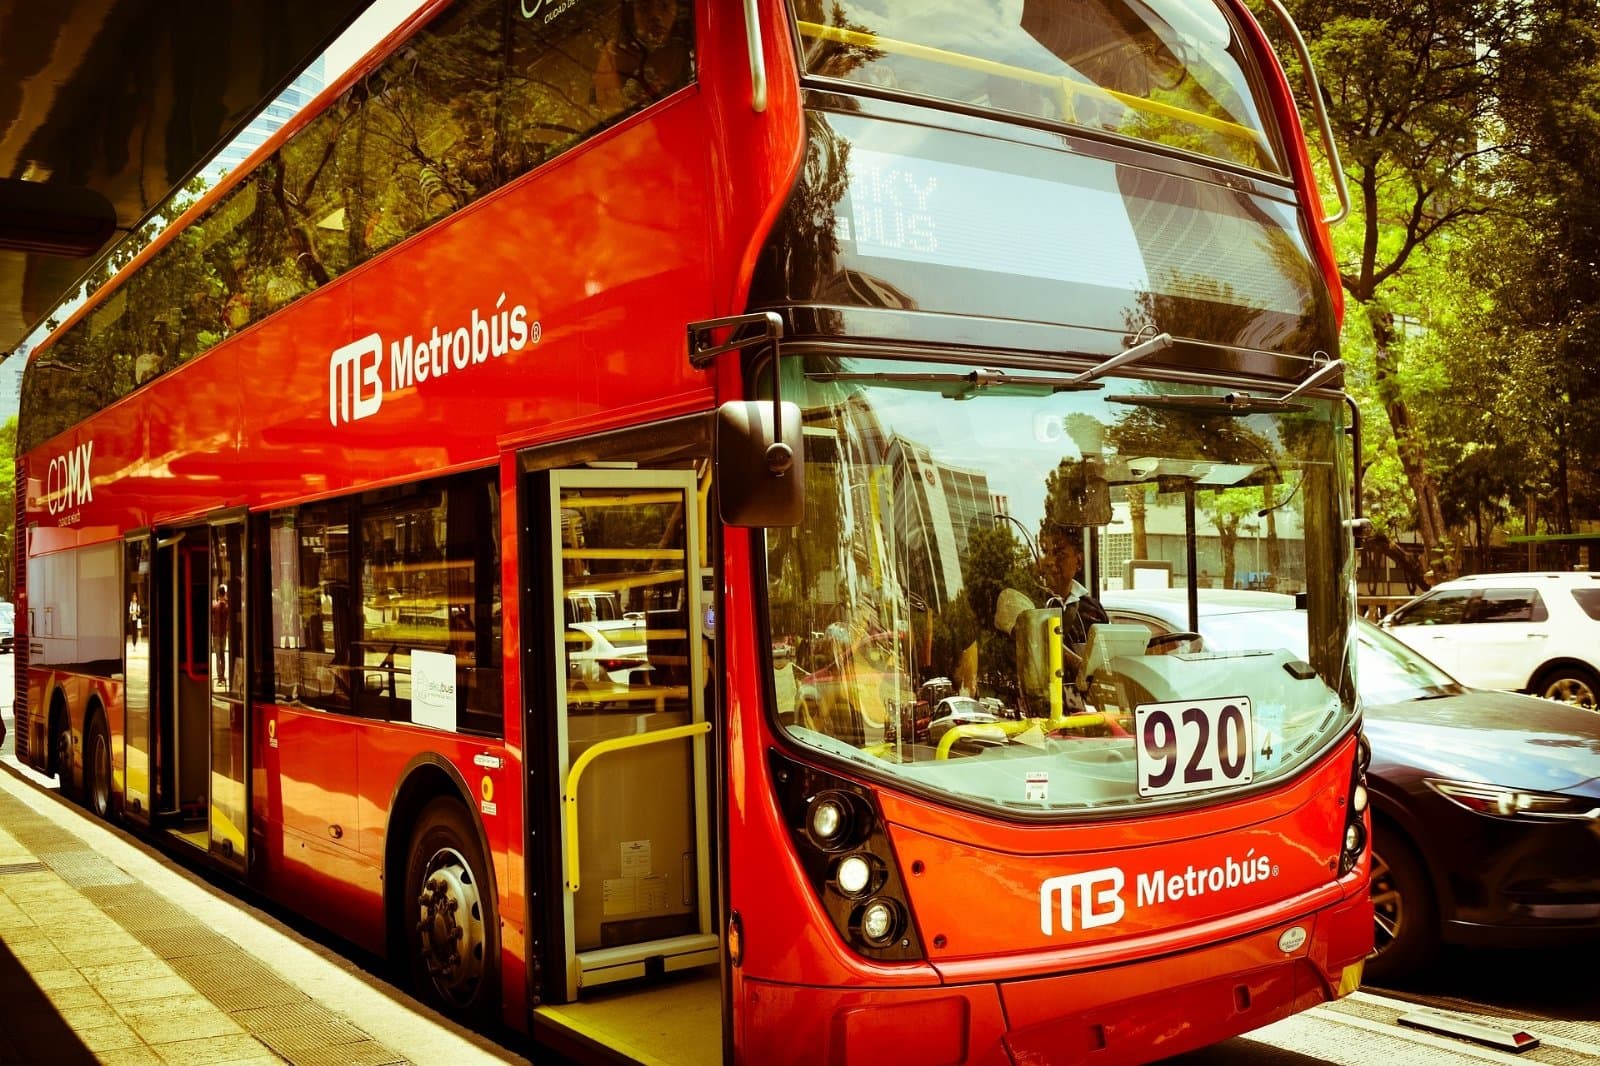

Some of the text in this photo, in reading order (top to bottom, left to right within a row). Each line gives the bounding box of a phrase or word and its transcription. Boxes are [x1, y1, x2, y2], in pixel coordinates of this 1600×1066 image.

[48, 440, 93, 516] CDMX
[1143, 704, 1248, 788] 920
[1260, 731, 1274, 760] 4
